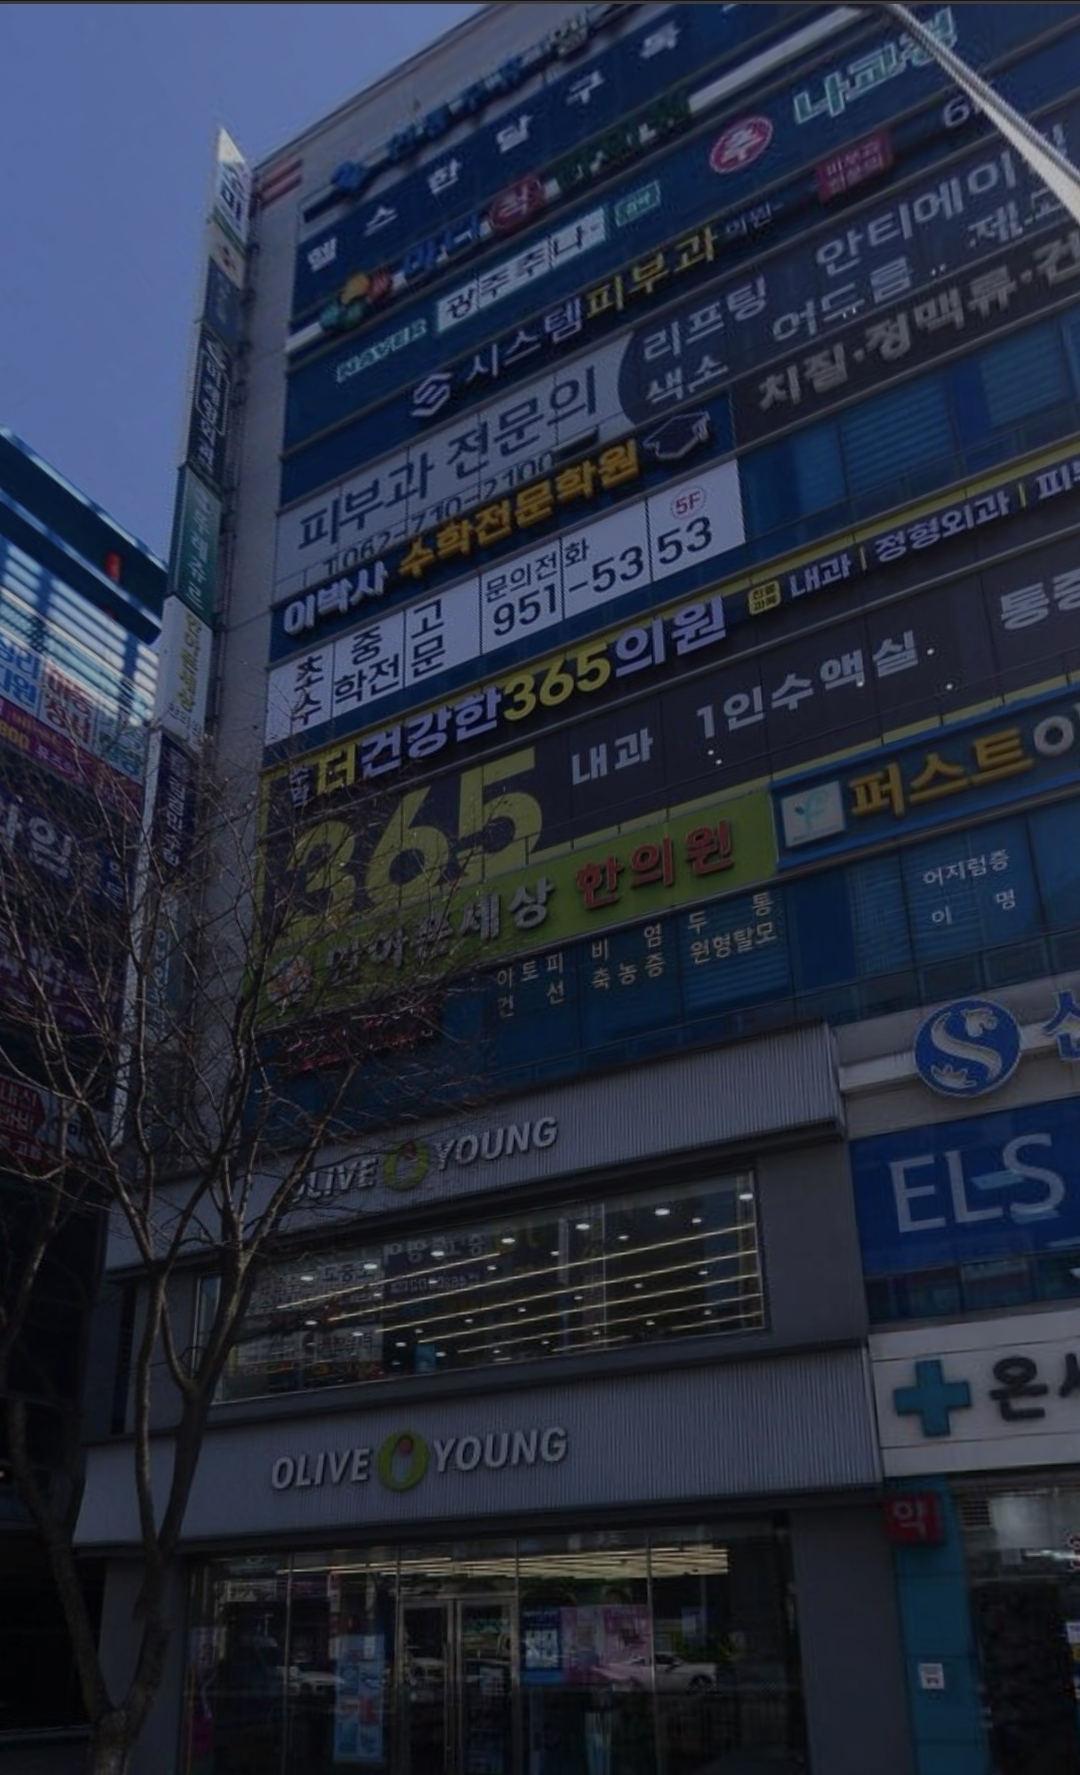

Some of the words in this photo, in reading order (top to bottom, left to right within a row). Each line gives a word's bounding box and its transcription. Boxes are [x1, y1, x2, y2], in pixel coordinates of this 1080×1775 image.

[643, 275, 768, 361] 리프팅
[647, 353, 729, 404] 색소
[298, 452, 434, 550] 피부과
[446, 363, 598, 480] 전문의
[397, 437, 644, 579] 수학전문학원
[874, 489, 1011, 564] 정형외과
[282, 559, 389, 636] 이박사
[486, 537, 589, 603] 문의전화
[788, 551, 854, 600] 내과
[351, 626, 382, 666] 중
[411, 599, 444, 639] 고
[570, 726, 655, 787] 내과
[576, 820, 734, 912] 한의원
[922, 848, 1011, 886] 어지럼증
[689, 922, 778, 966] 원형탈모
[290, 1156, 379, 1201] LIVE
[434, 1116, 559, 1173] YOUNG
[271, 1447, 371, 1491] OLIVE
[433, 1426, 568, 1474] YOUNG
